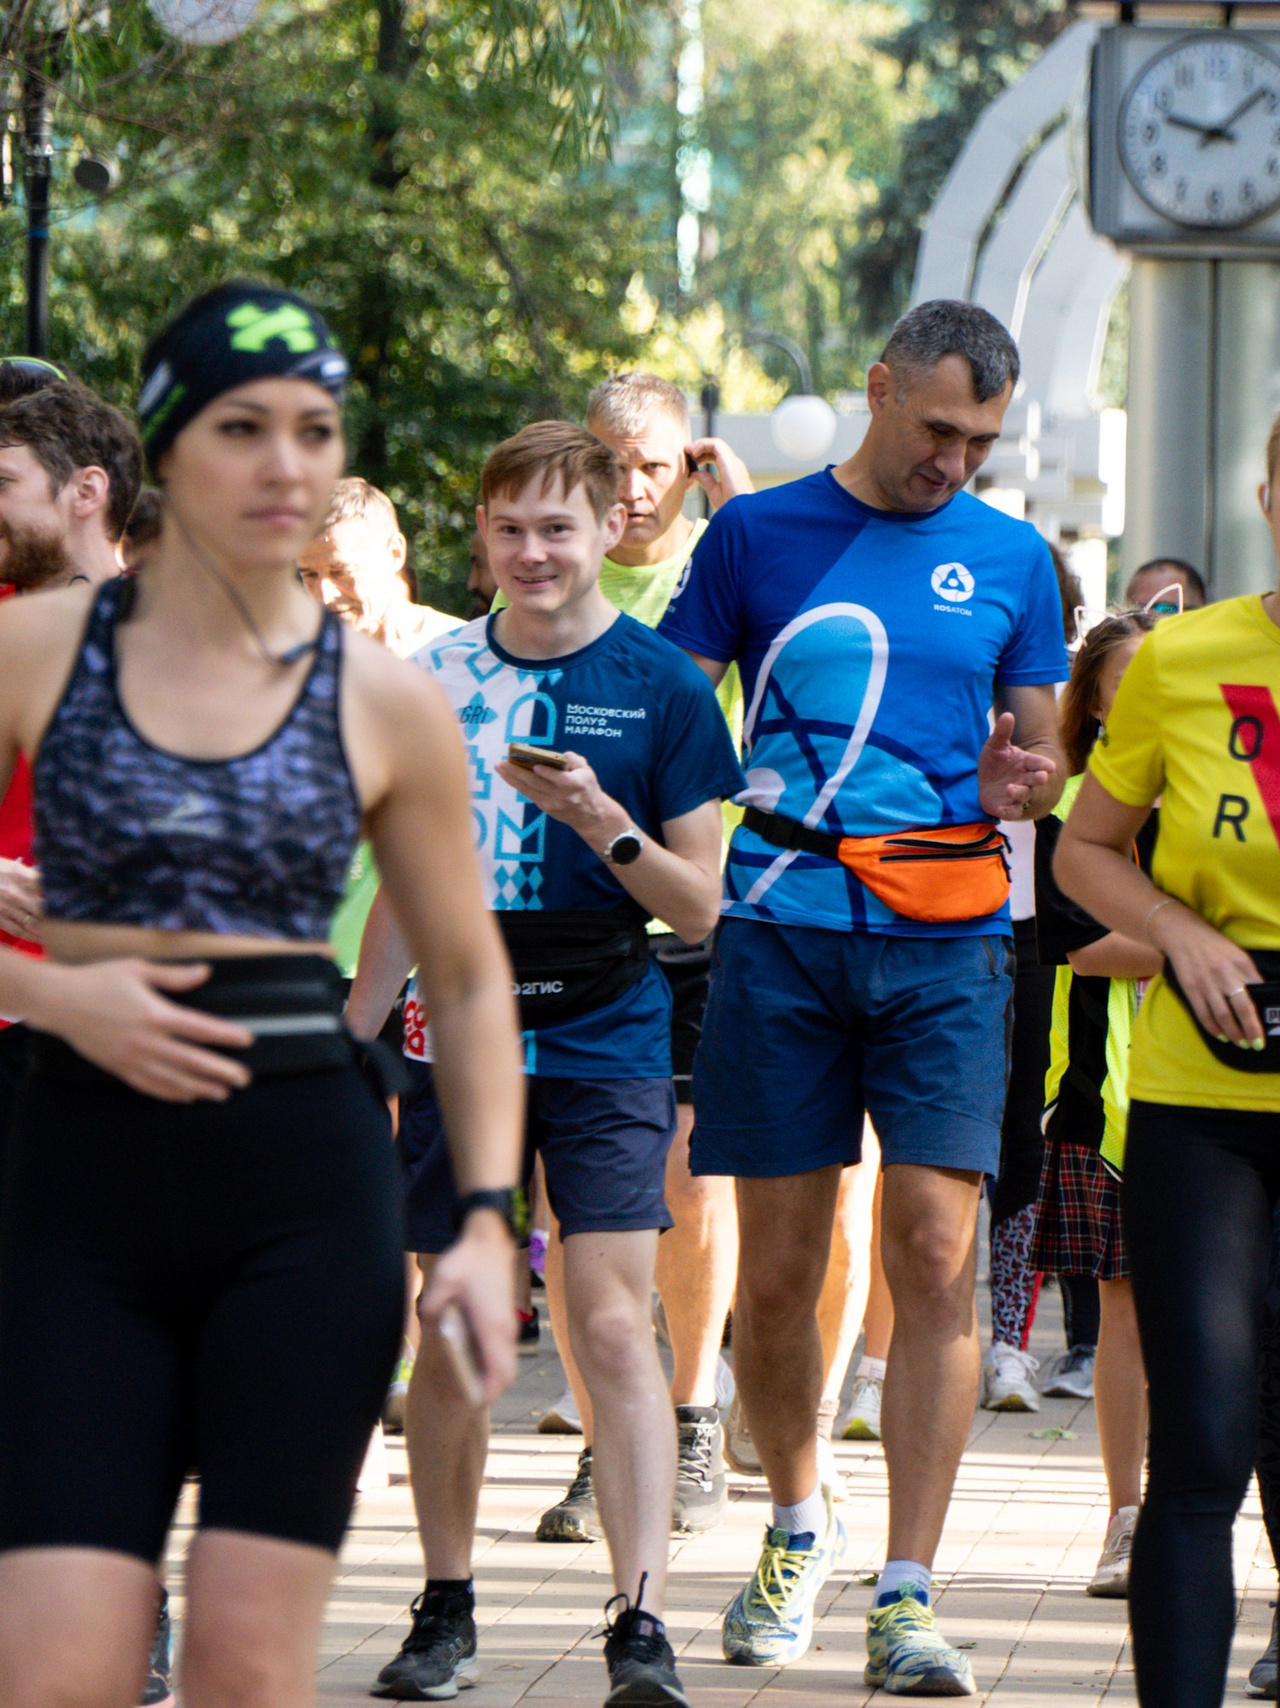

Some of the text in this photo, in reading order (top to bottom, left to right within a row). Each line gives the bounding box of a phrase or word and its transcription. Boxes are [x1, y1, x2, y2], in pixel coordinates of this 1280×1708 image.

[933, 604, 973, 617] ROSATOM
[565, 725, 622, 738] МАРАФОН
[521, 980, 564, 996] 2ГИС
